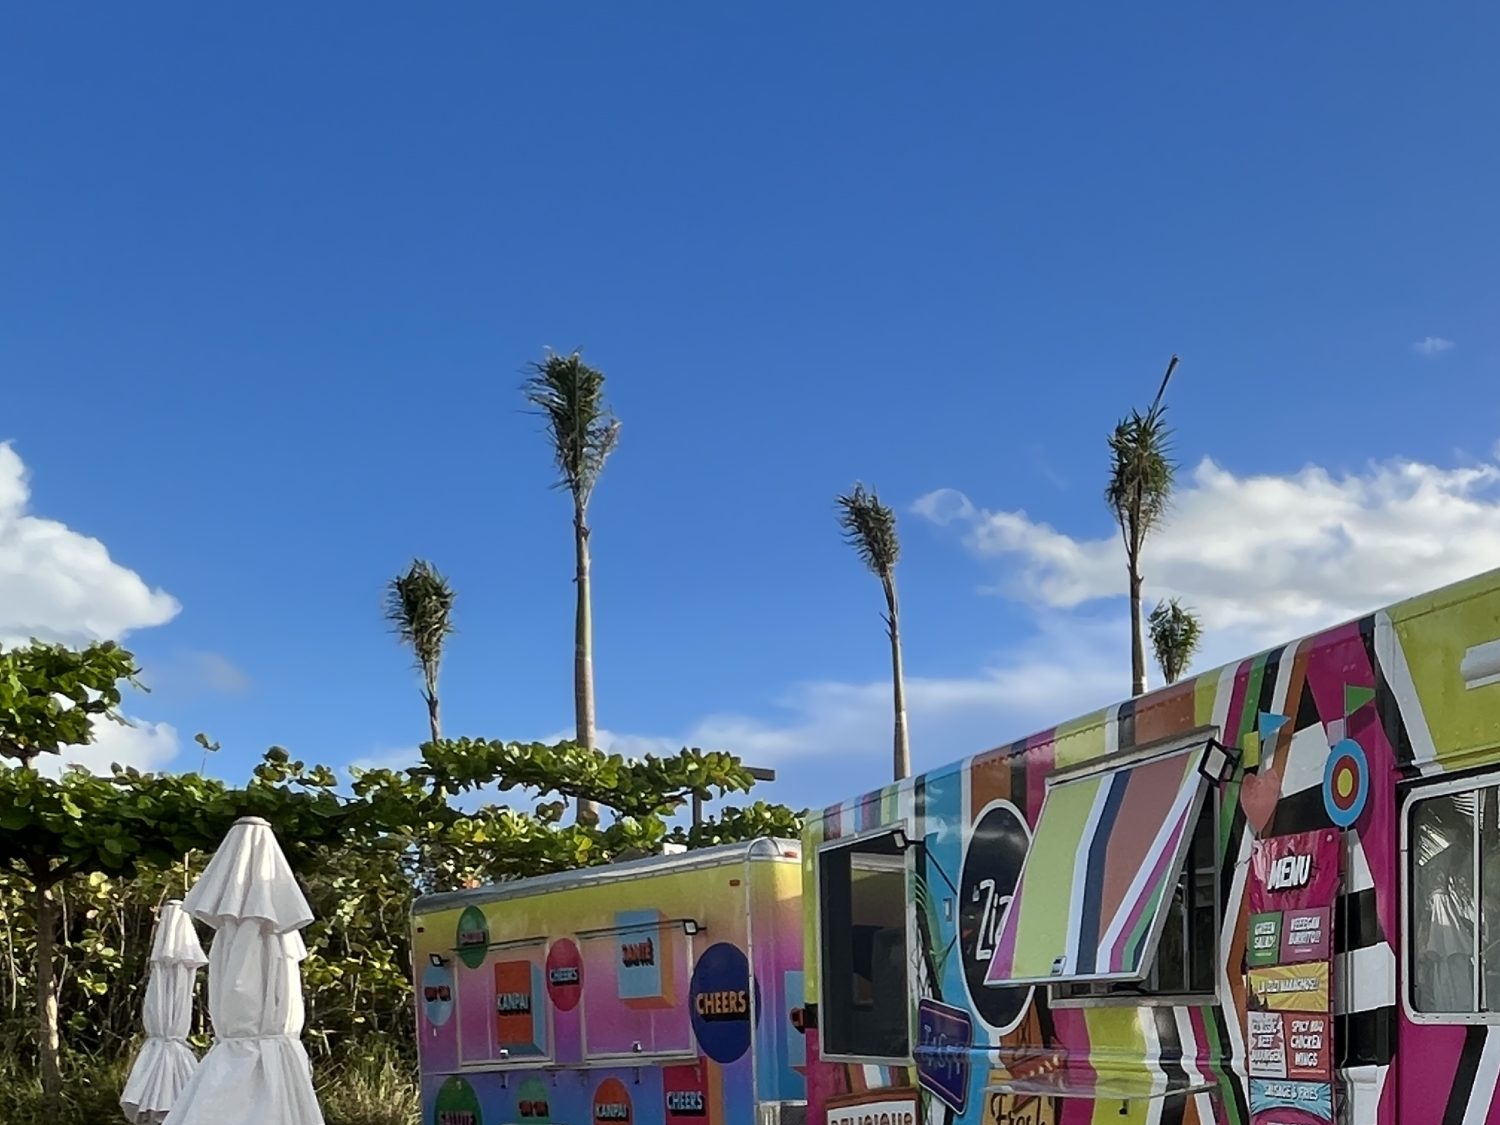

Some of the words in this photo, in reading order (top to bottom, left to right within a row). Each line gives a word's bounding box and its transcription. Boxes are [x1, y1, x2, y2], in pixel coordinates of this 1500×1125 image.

[1267, 853, 1311, 891] MENU
[496, 992, 530, 1012] KANPAI
[695, 990, 747, 1016] CHEERS
[595, 1103, 629, 1119] KANPAI
[666, 1091, 704, 1111] CHEERS
